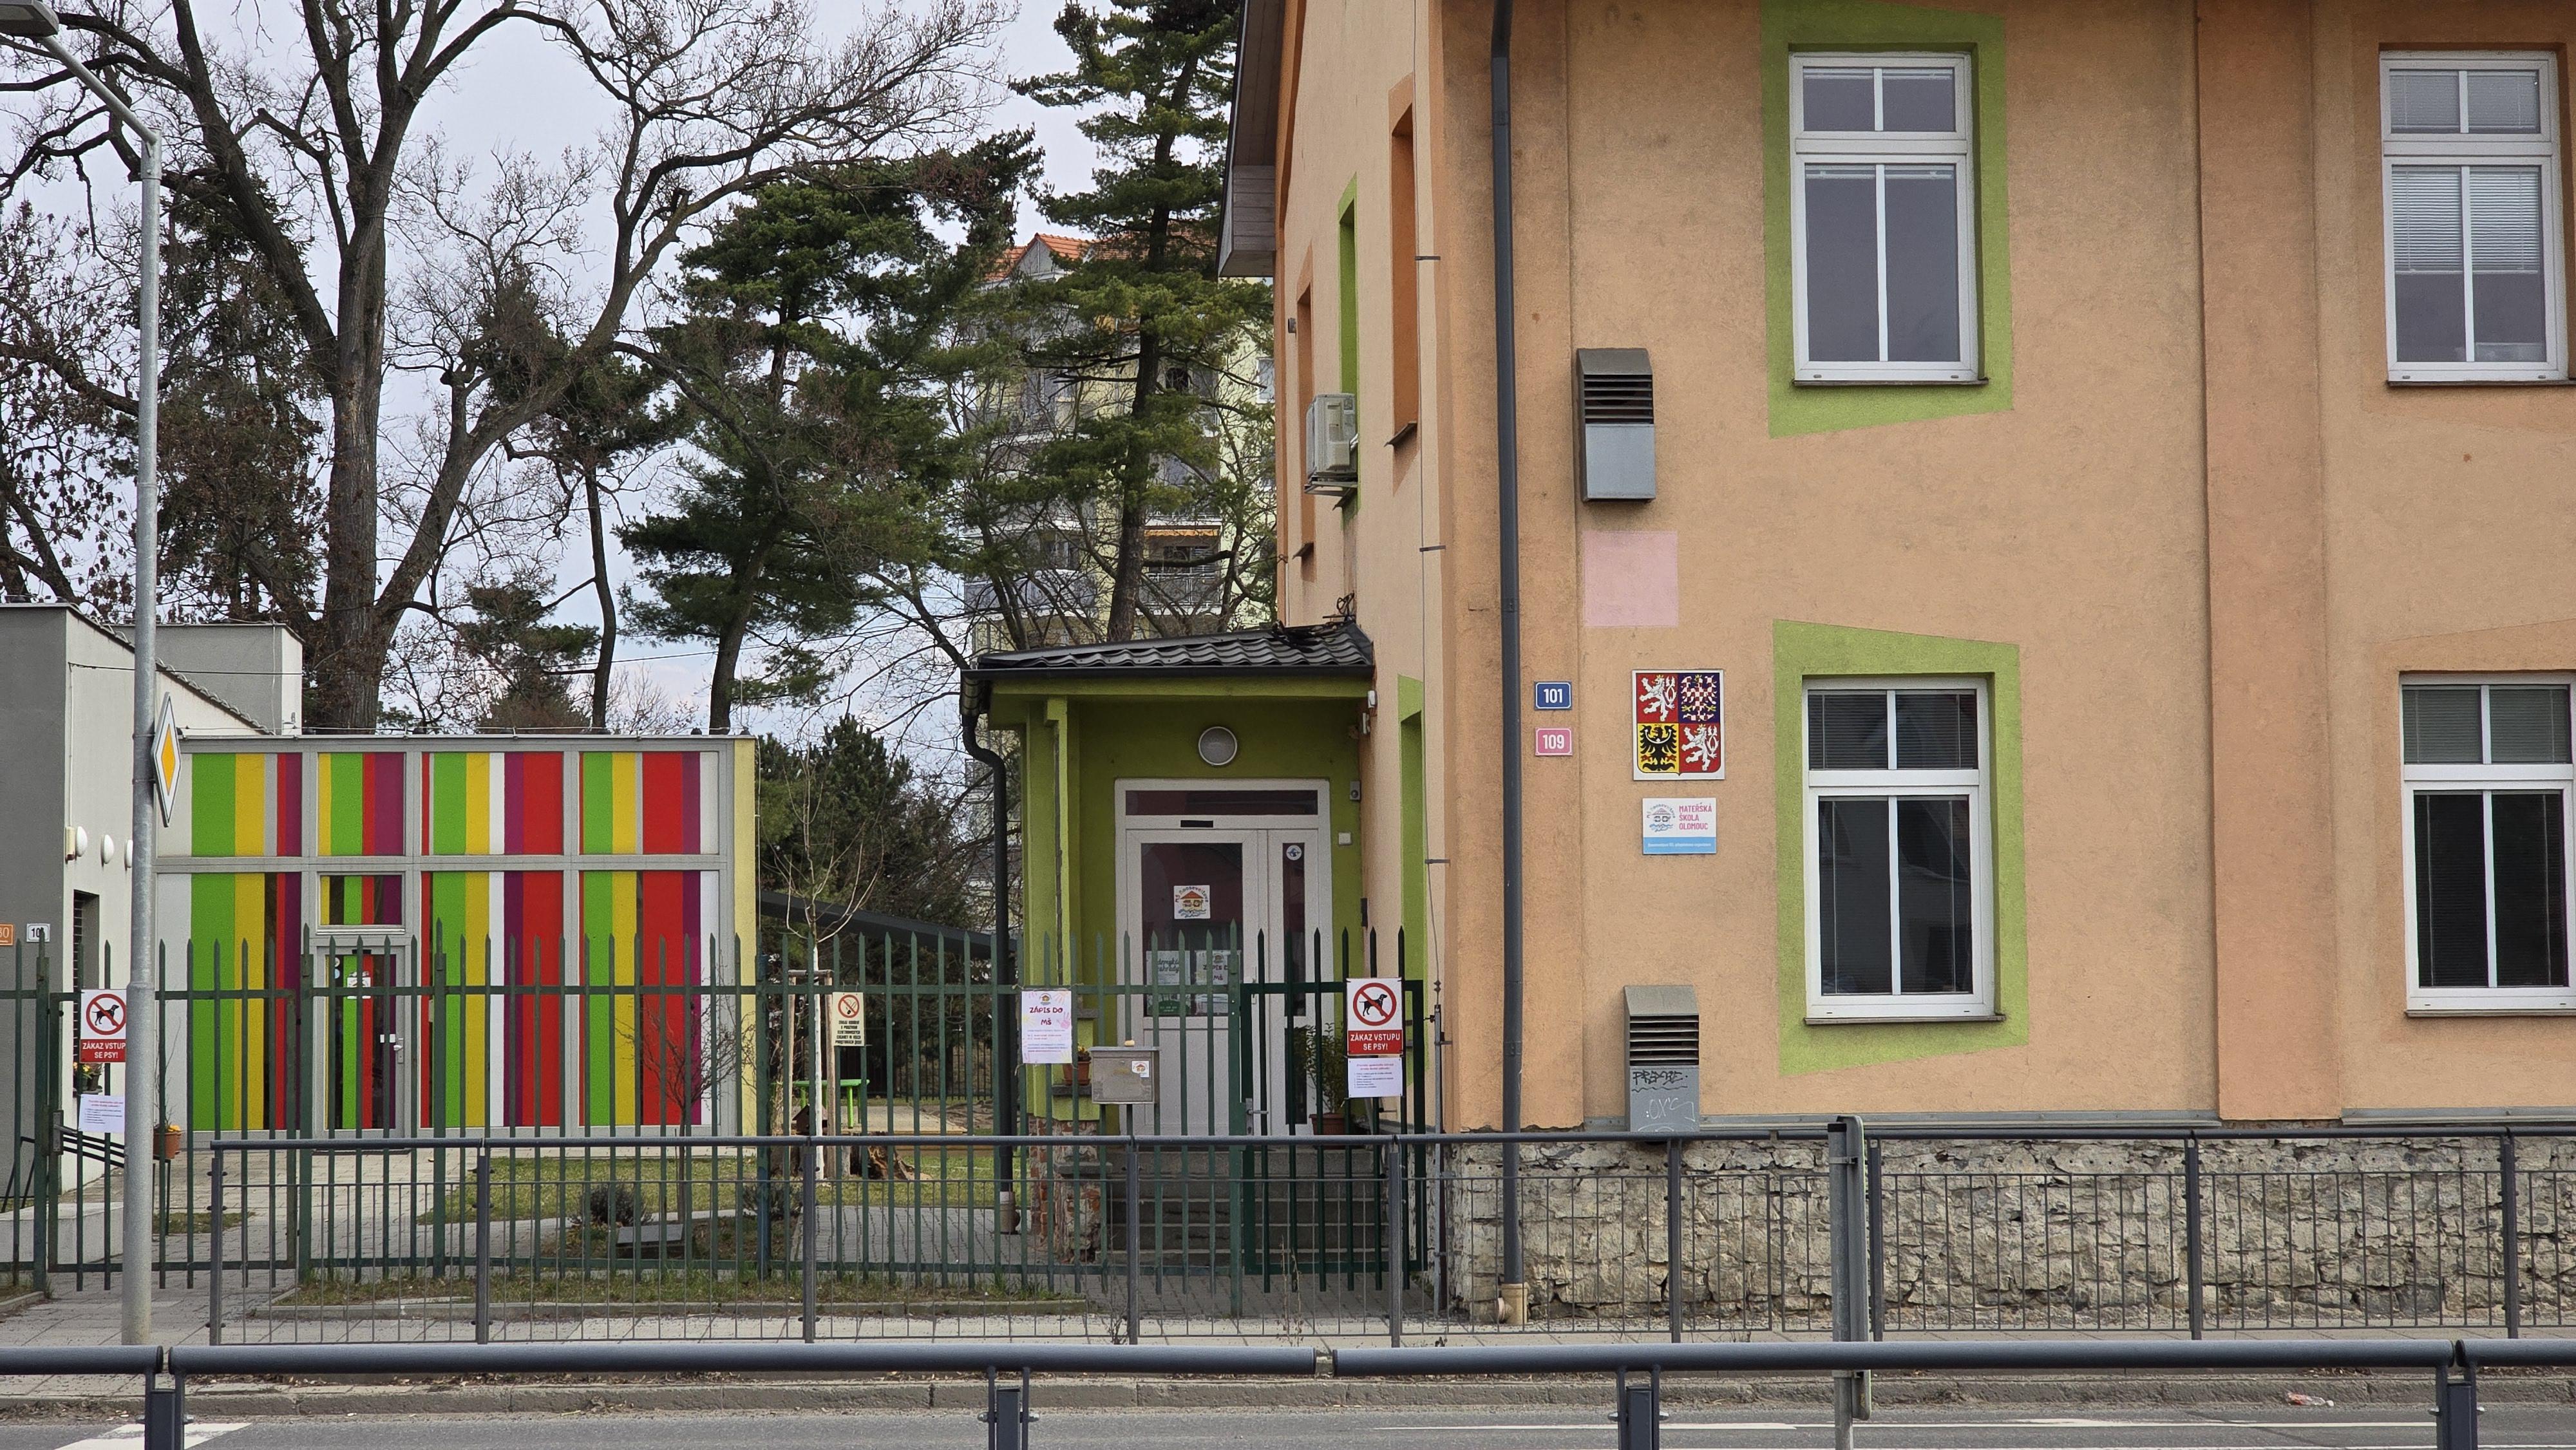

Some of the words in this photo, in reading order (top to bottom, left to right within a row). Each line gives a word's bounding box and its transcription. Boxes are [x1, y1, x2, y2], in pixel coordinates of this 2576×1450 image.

[1544, 688, 1563, 703] 101
[1542, 735, 1565, 749] 109
[1679, 802, 1712, 813] MATEŘSKÁ
[1679, 813, 1699, 822] ŠKOLA
[1350, 1033, 1372, 1041] ZÁKAZ
[82, 1041, 104, 1050] ZÁKAZ
